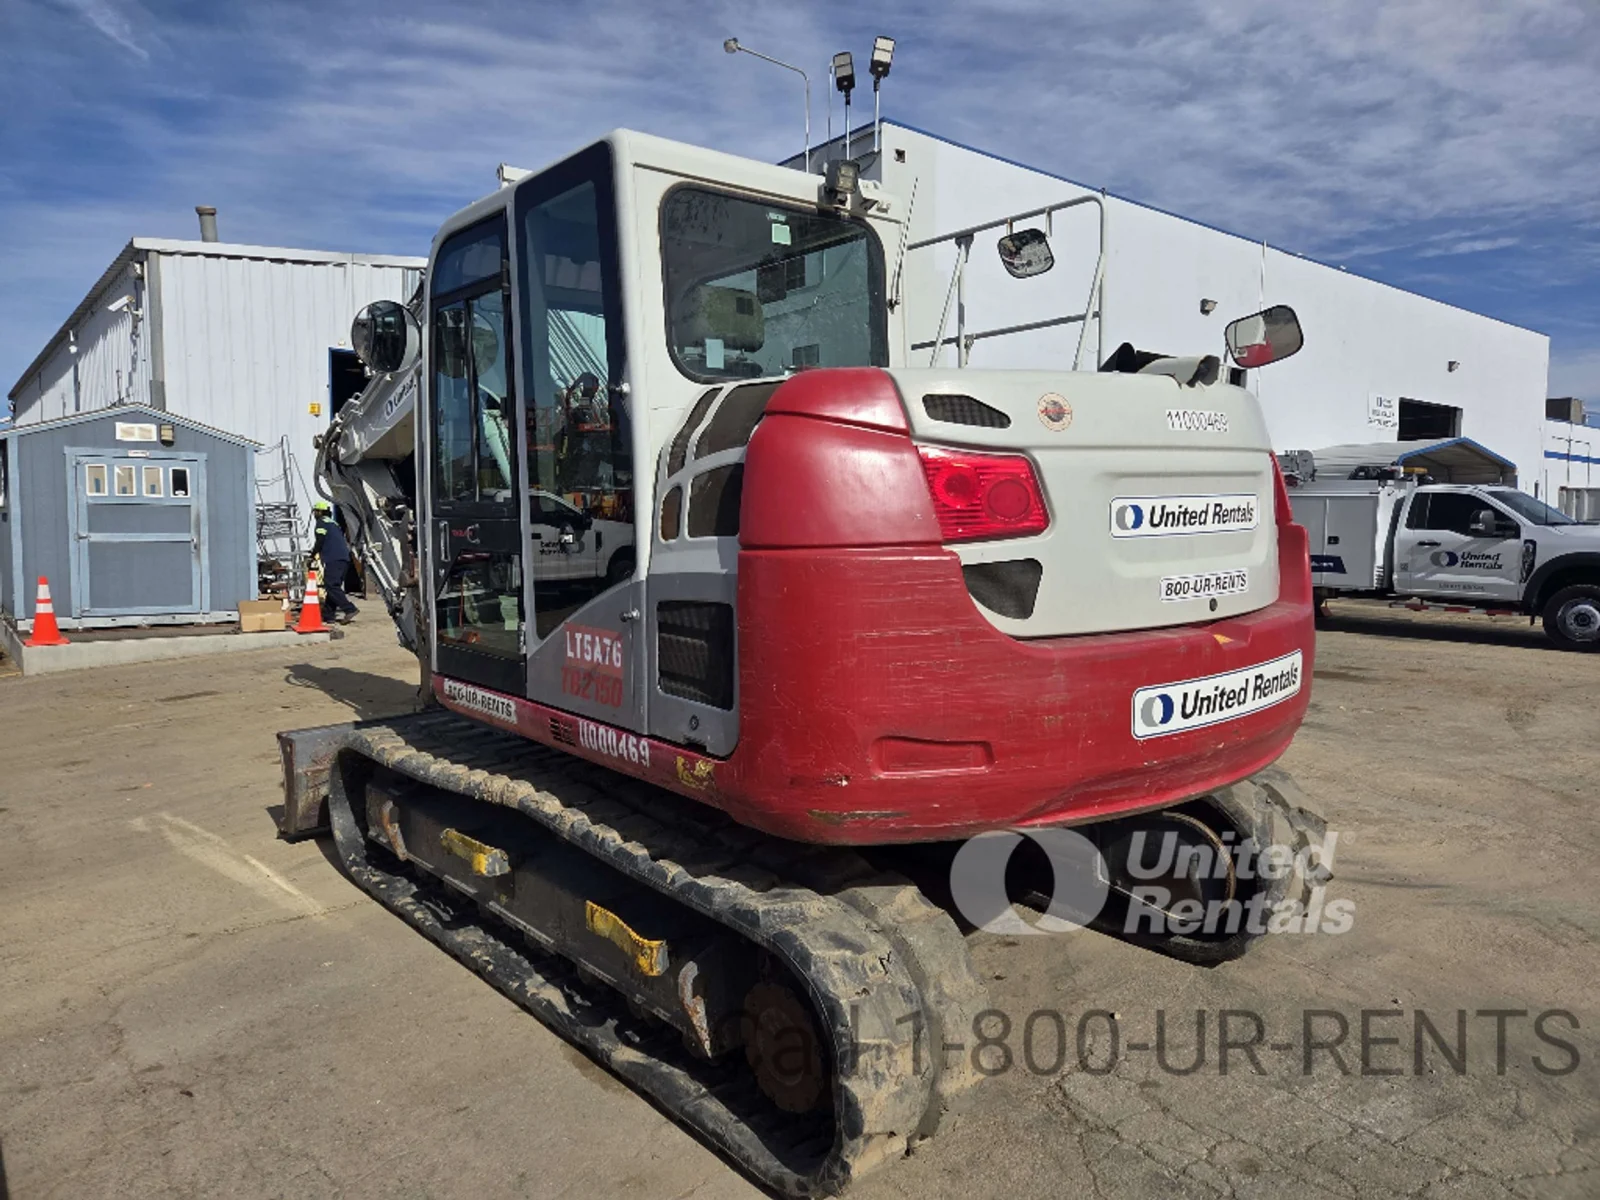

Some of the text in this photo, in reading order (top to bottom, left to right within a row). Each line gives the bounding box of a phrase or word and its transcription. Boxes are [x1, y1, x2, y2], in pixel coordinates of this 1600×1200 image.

[1167, 410, 1228, 432] 11000469
[1150, 501, 1254, 528] United Rentals
[1165, 573, 1247, 596] 800-UR-RENTS
[566, 630, 622, 669] LT5A76
[1181, 662, 1299, 720] United Rentals
